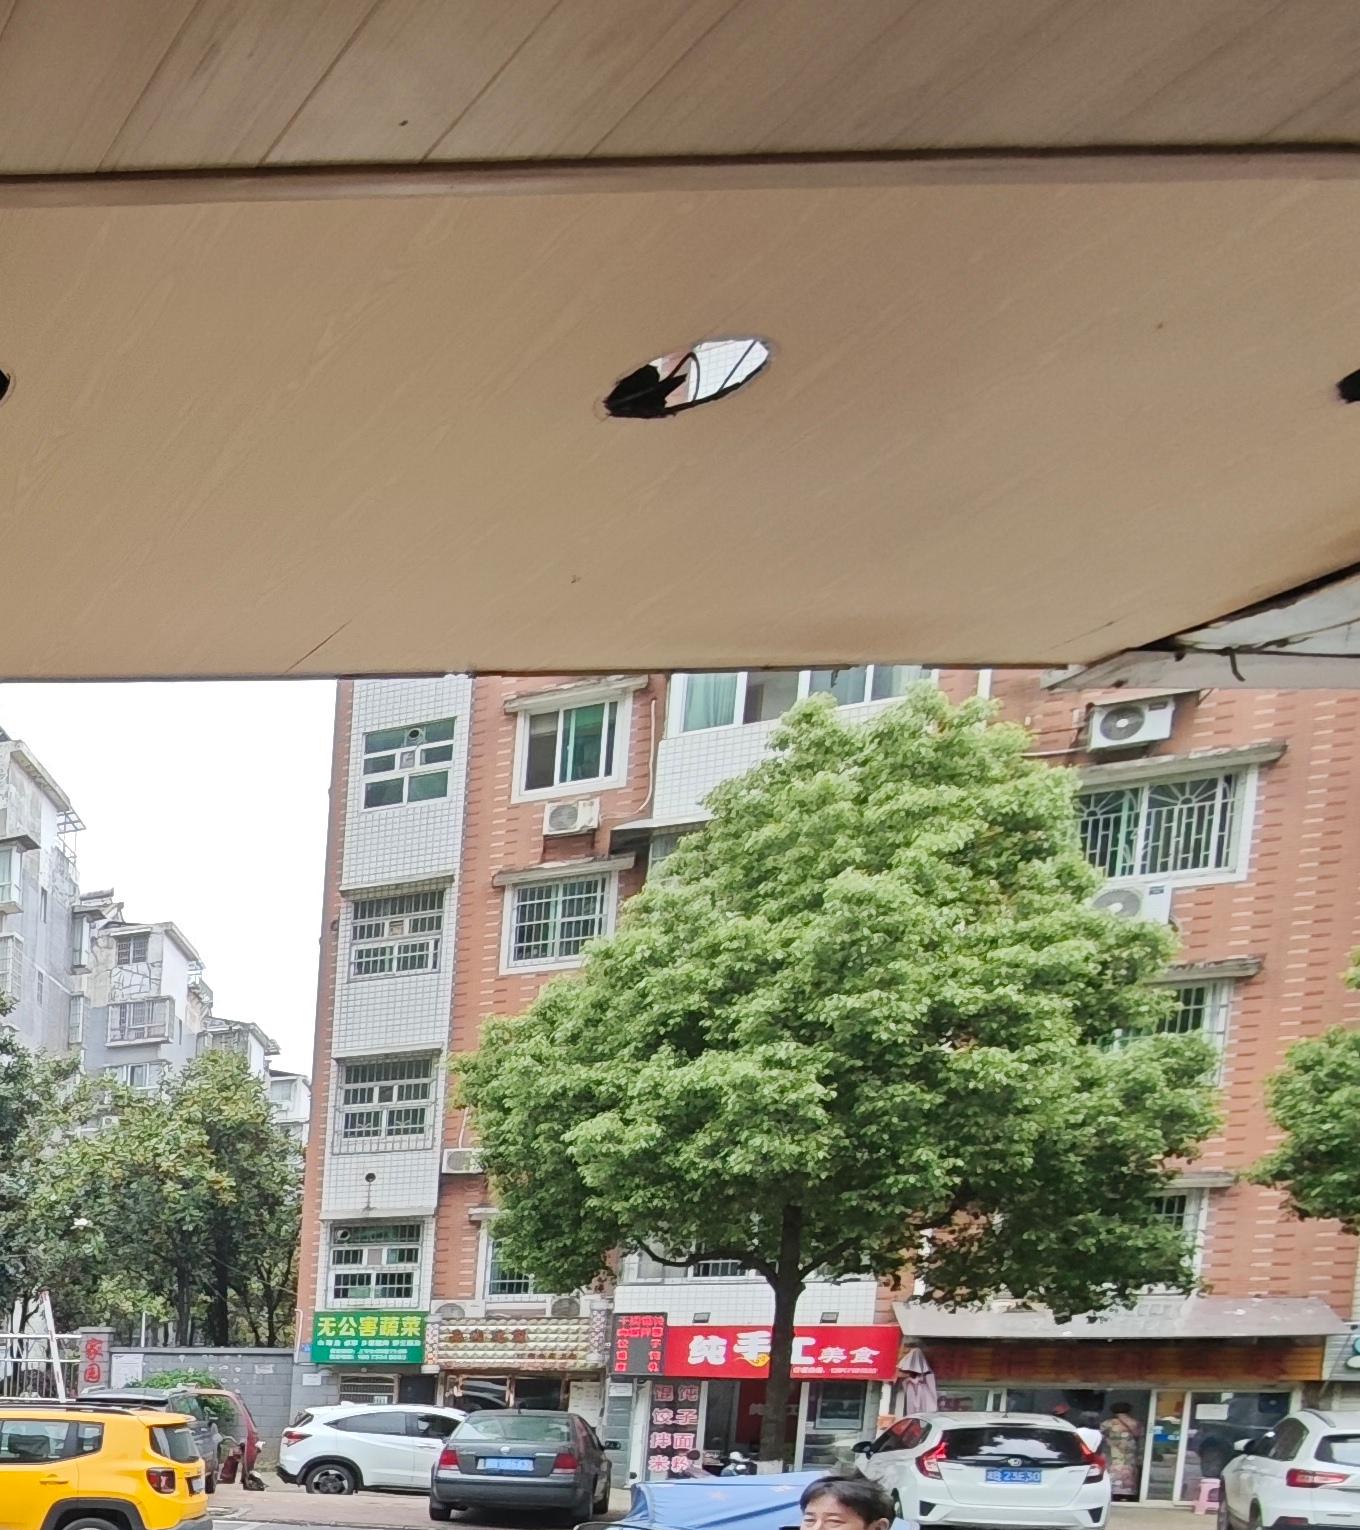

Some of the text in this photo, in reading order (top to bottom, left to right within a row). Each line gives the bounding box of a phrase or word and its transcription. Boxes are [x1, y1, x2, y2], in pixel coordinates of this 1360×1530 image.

[317, 1316, 421, 1337] 无公害蔬菜
[652, 1407, 698, 1426] 饺子
[649, 1432, 696, 1450] 拌面
[648, 1454, 691, 1474] 米粉
